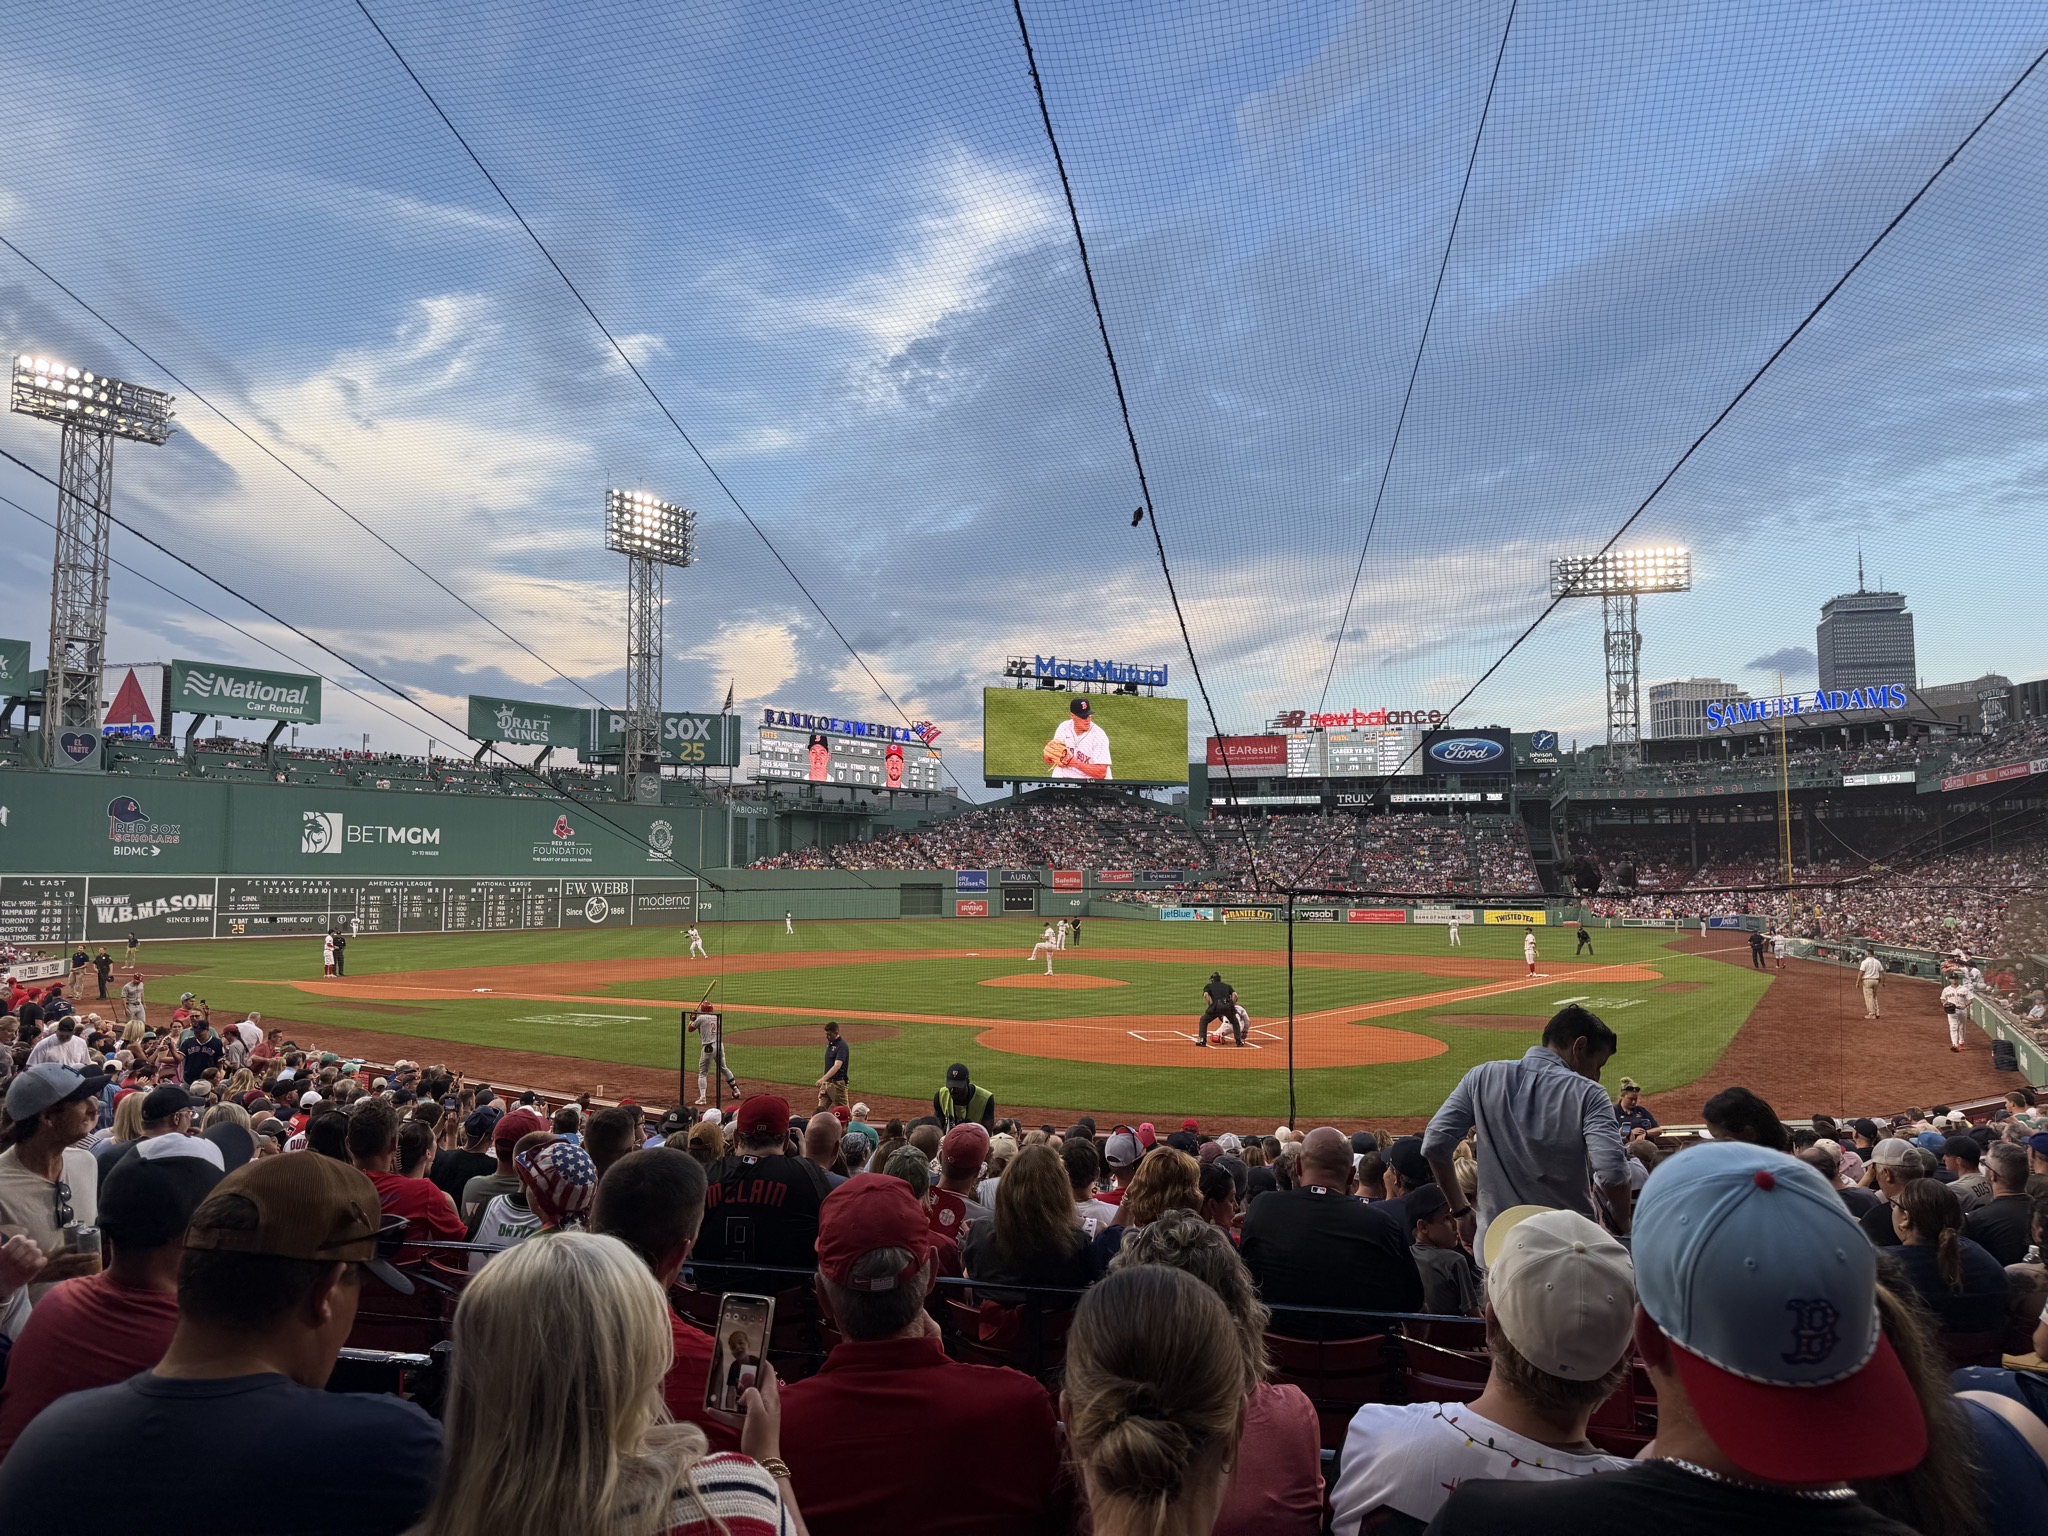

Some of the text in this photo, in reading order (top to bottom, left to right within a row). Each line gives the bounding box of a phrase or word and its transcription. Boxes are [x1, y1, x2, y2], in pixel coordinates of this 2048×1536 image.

[1035, 655, 1168, 686] MassMutual
[212, 676, 309, 704] National
[246, 702, 303, 714] Car Rental
[1706, 683, 1907, 731] SAMUEL ADAMS
[1309, 707, 1441, 727] new balance
[496, 716, 550, 731] DRAFT
[664, 718, 711, 740] SOX
[764, 709, 912, 742] BANK OF AMERICA
[504, 728, 549, 742] KINGS
[680, 742, 705, 761] 25
[1444, 742, 1488, 759] Ford
[838, 771, 876, 783] 0 0 0
[1337, 794, 1374, 804] TRULY
[116, 823, 180, 834] RED SOX
[114, 834, 180, 843] SCHOLARS
[347, 825, 440, 845] BETMGM
[114, 846, 149, 856] BIDMC
[533, 847, 592, 855] FOUNDATION
[591, 882, 629, 894] WEBB
[91, 896, 113, 905] WHO
[639, 896, 691, 906] moderna
[1163, 909, 1190, 919] jetBlue
[1257, 910, 1273, 919] CITY
[1495, 914, 1534, 923] TWISTED TEA
[232, 924, 245, 934] 29
[1780, 1298, 1840, 1365] B
